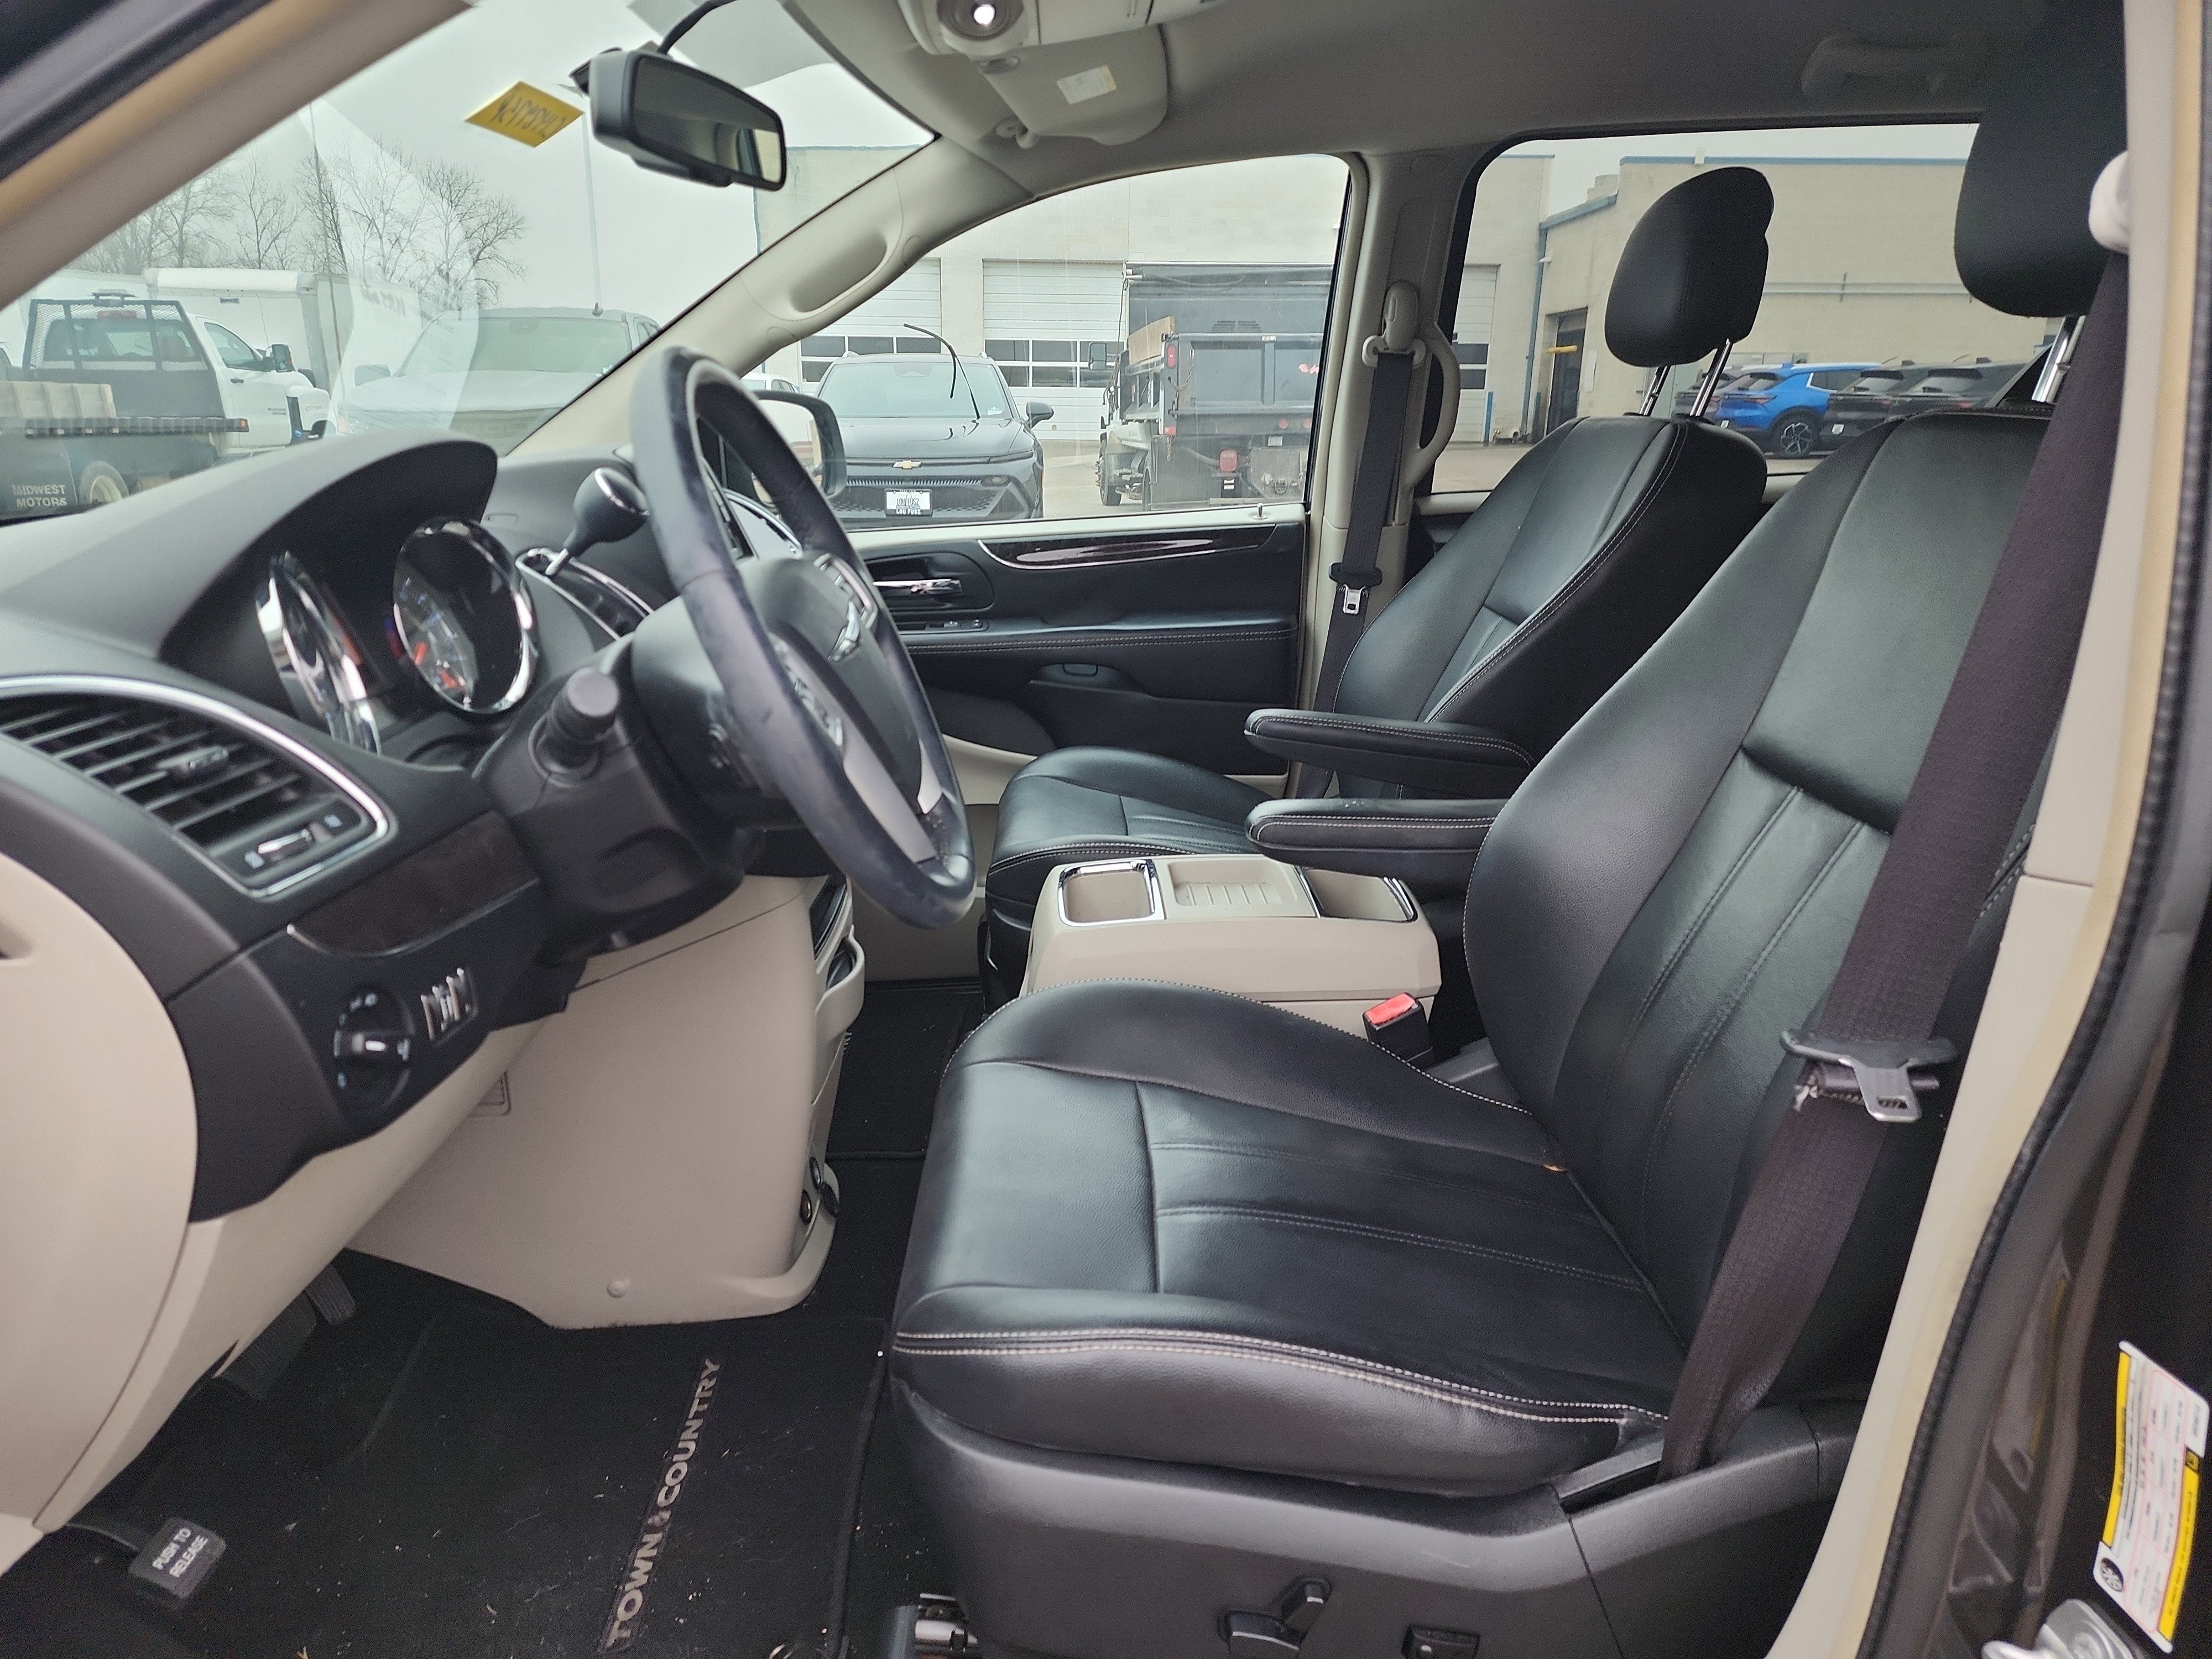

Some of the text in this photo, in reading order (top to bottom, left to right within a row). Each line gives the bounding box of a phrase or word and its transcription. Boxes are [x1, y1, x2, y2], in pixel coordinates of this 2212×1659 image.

[12, 484, 66, 495] MIDWEST
[17, 497, 67, 507] MOTORS
[605, 1533, 663, 1648] TOWN
[657, 1358, 720, 1507] COUNTRY
[173, 1527, 191, 1543] TO
